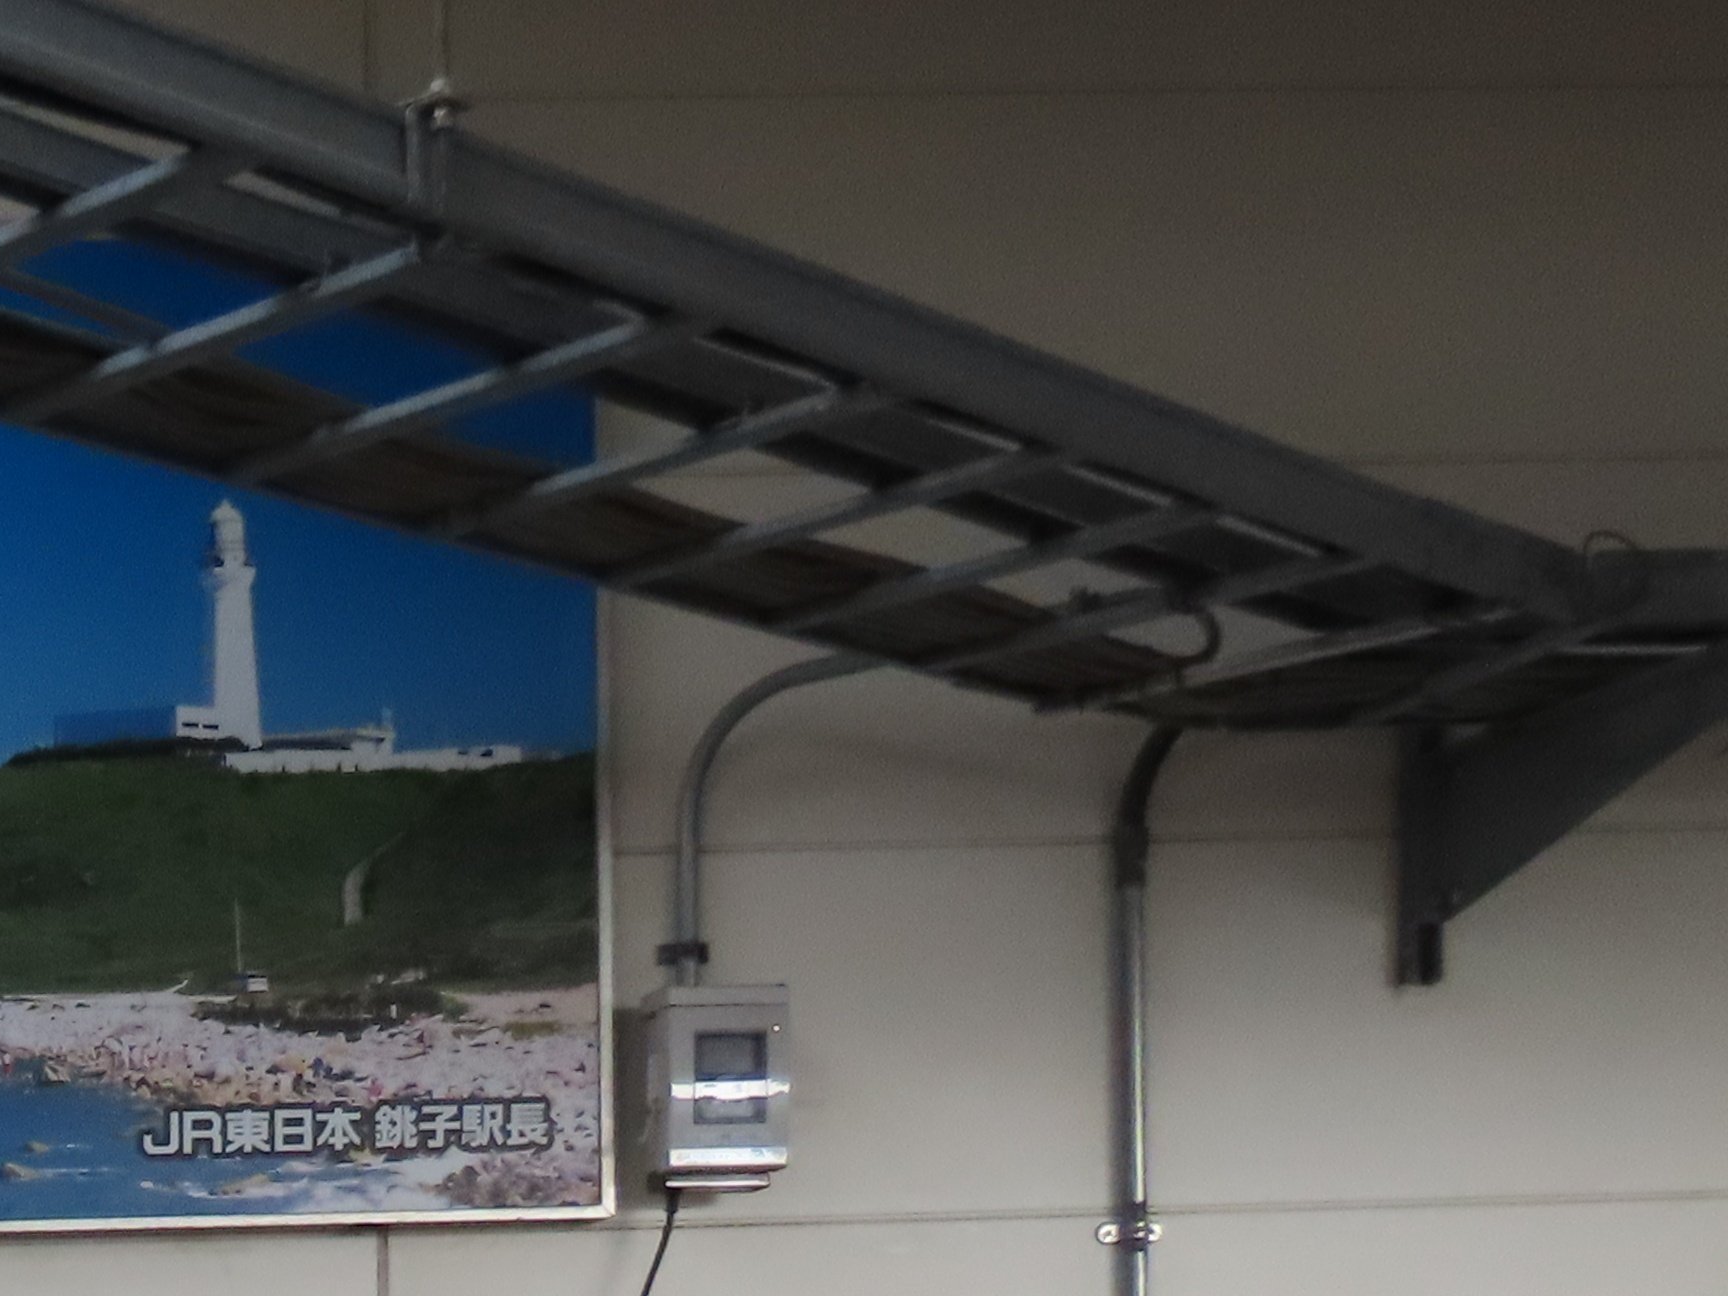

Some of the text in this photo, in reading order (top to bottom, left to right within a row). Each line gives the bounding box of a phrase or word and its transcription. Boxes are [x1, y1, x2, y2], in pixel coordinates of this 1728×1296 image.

[144, 1102, 550, 1156] JR東日本 銚子駅長
